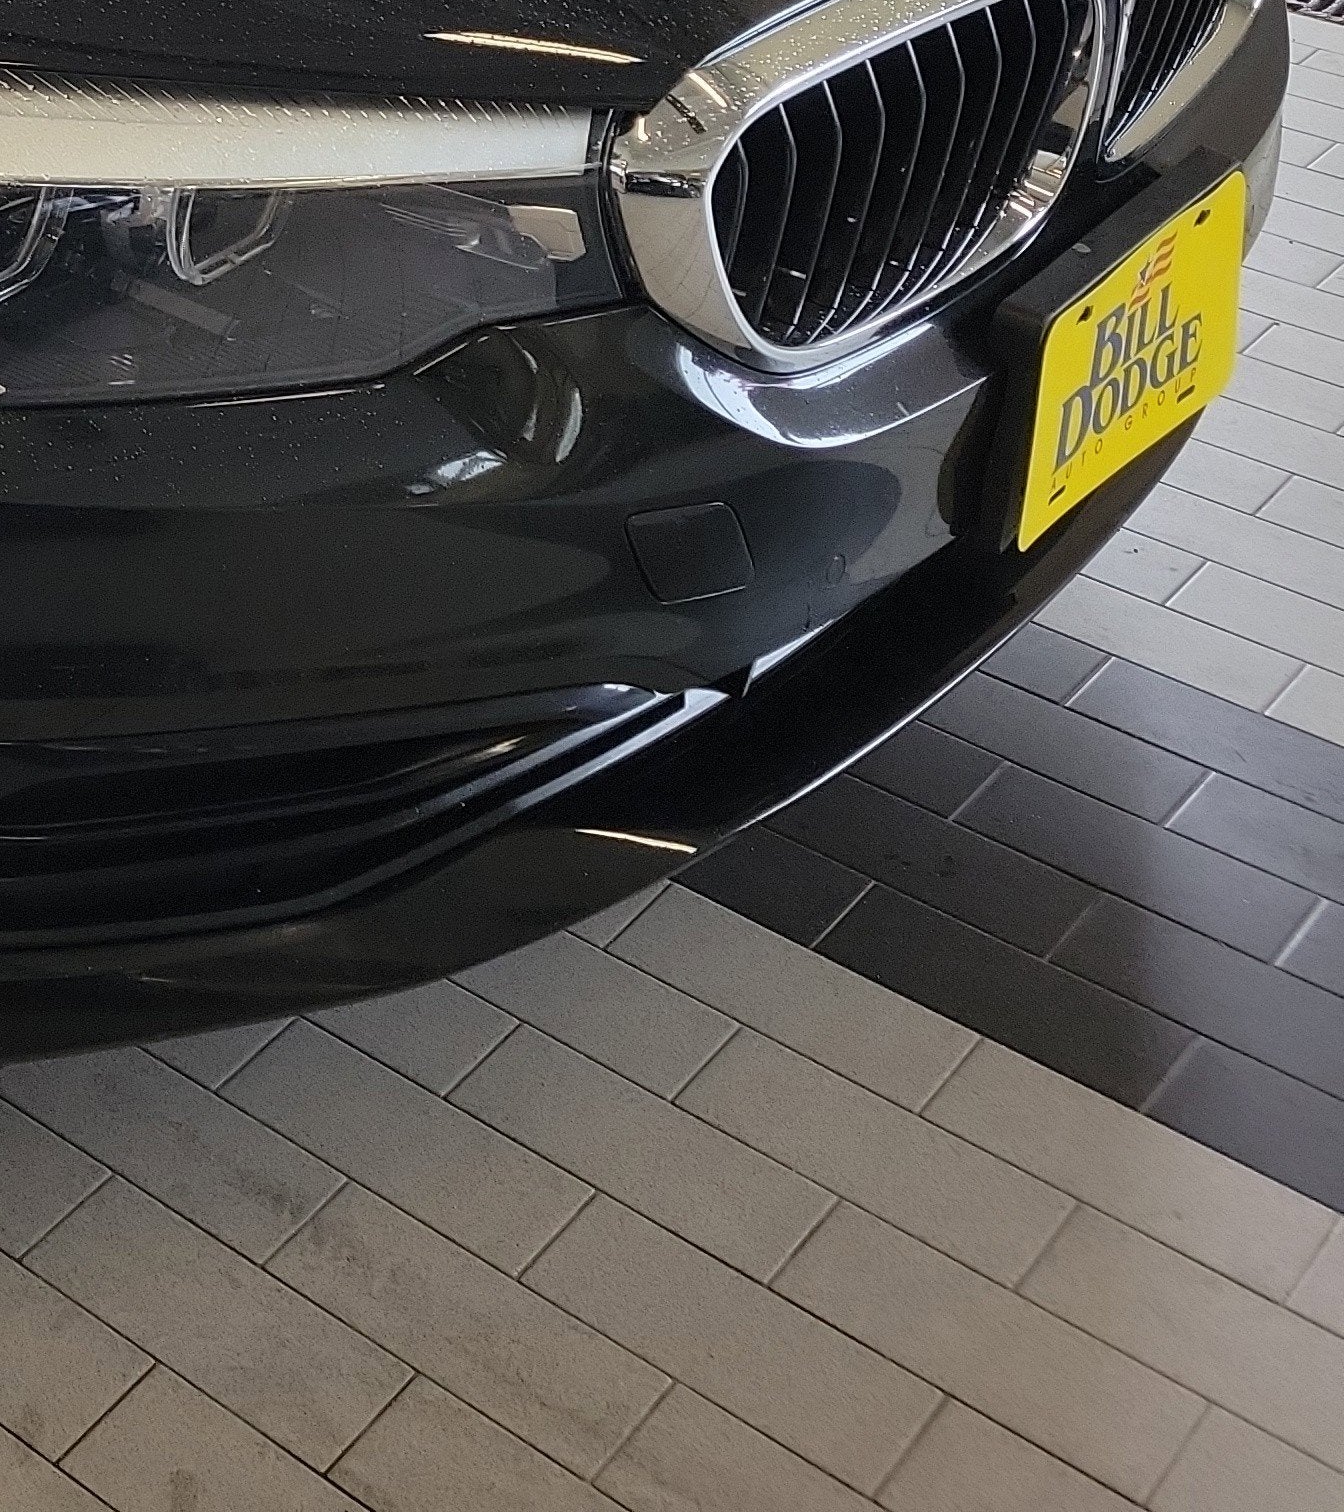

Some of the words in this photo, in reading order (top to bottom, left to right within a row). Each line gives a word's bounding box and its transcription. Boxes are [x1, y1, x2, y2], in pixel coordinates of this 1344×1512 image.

[1052, 312, 1202, 475] DODGE
[1089, 281, 1180, 388] BILL
[1050, 438, 1103, 492] AUTO
[1124, 367, 1197, 431] GROUP
